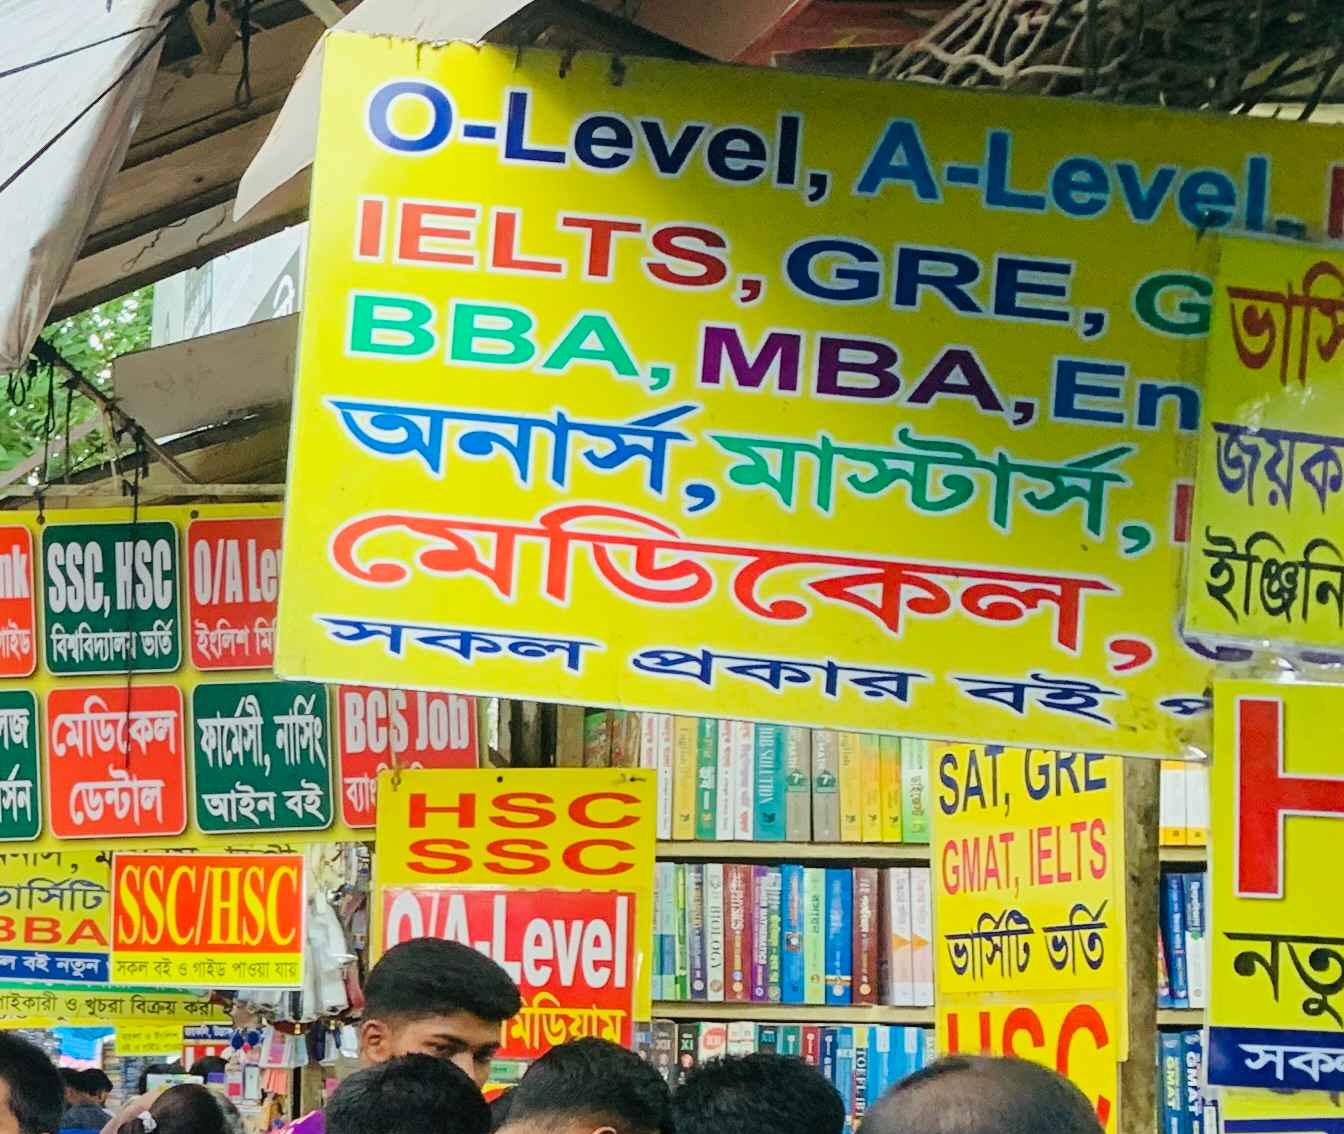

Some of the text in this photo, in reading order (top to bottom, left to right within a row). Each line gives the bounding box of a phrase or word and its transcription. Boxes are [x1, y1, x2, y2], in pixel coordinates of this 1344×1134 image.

[369, 81, 828, 203] O-Level,
[359, 199, 762, 303] IELTS,
[787, 239, 1105, 337] GRE,
[350, 293, 672, 391] BBA,
[701, 325, 1034, 427] MBA,
[328, 399, 716, 512] অনার্স,
[711, 428, 1152, 554] মাস্টার্স,
[47, 539, 173, 618] SSC, HSC
[193, 538, 281, 605] O/A Le
[332, 505, 1153, 670] মেডিকেল,
[318, 618, 602, 671] সকল
[632, 648, 926, 703] প্রকার
[955, 673, 1123, 725] বই
[52, 694, 178, 757] মেডিকেল
[344, 689, 470, 754] BCS Job
[69, 762, 166, 827] ডেন্টাল
[202, 779, 326, 826] আইন বই
[408, 791, 641, 829] HSC
[759, 750, 775, 804] SOLUTION
[937, 745, 1108, 817] SAT, GRE
[405, 838, 637, 876] SSC
[941, 818, 1108, 899] GMAT, IELTS
[118, 864, 298, 945] SSC/HSC
[22, 953, 50, 974] বই
[56, 956, 100, 979] নতুন
[154, 960, 171, 977] বই
[177, 963, 187, 976] ও
[944, 909, 1034, 982] ভার্সিটি
[1042, 899, 1109, 977] ভর্তি
[64, 997, 77, 1012] ও
[84, 996, 124, 1017] খুচরা
[131, 995, 176, 1015] বিক্রয়
[1186, 1050, 1200, 1115] GMAT
